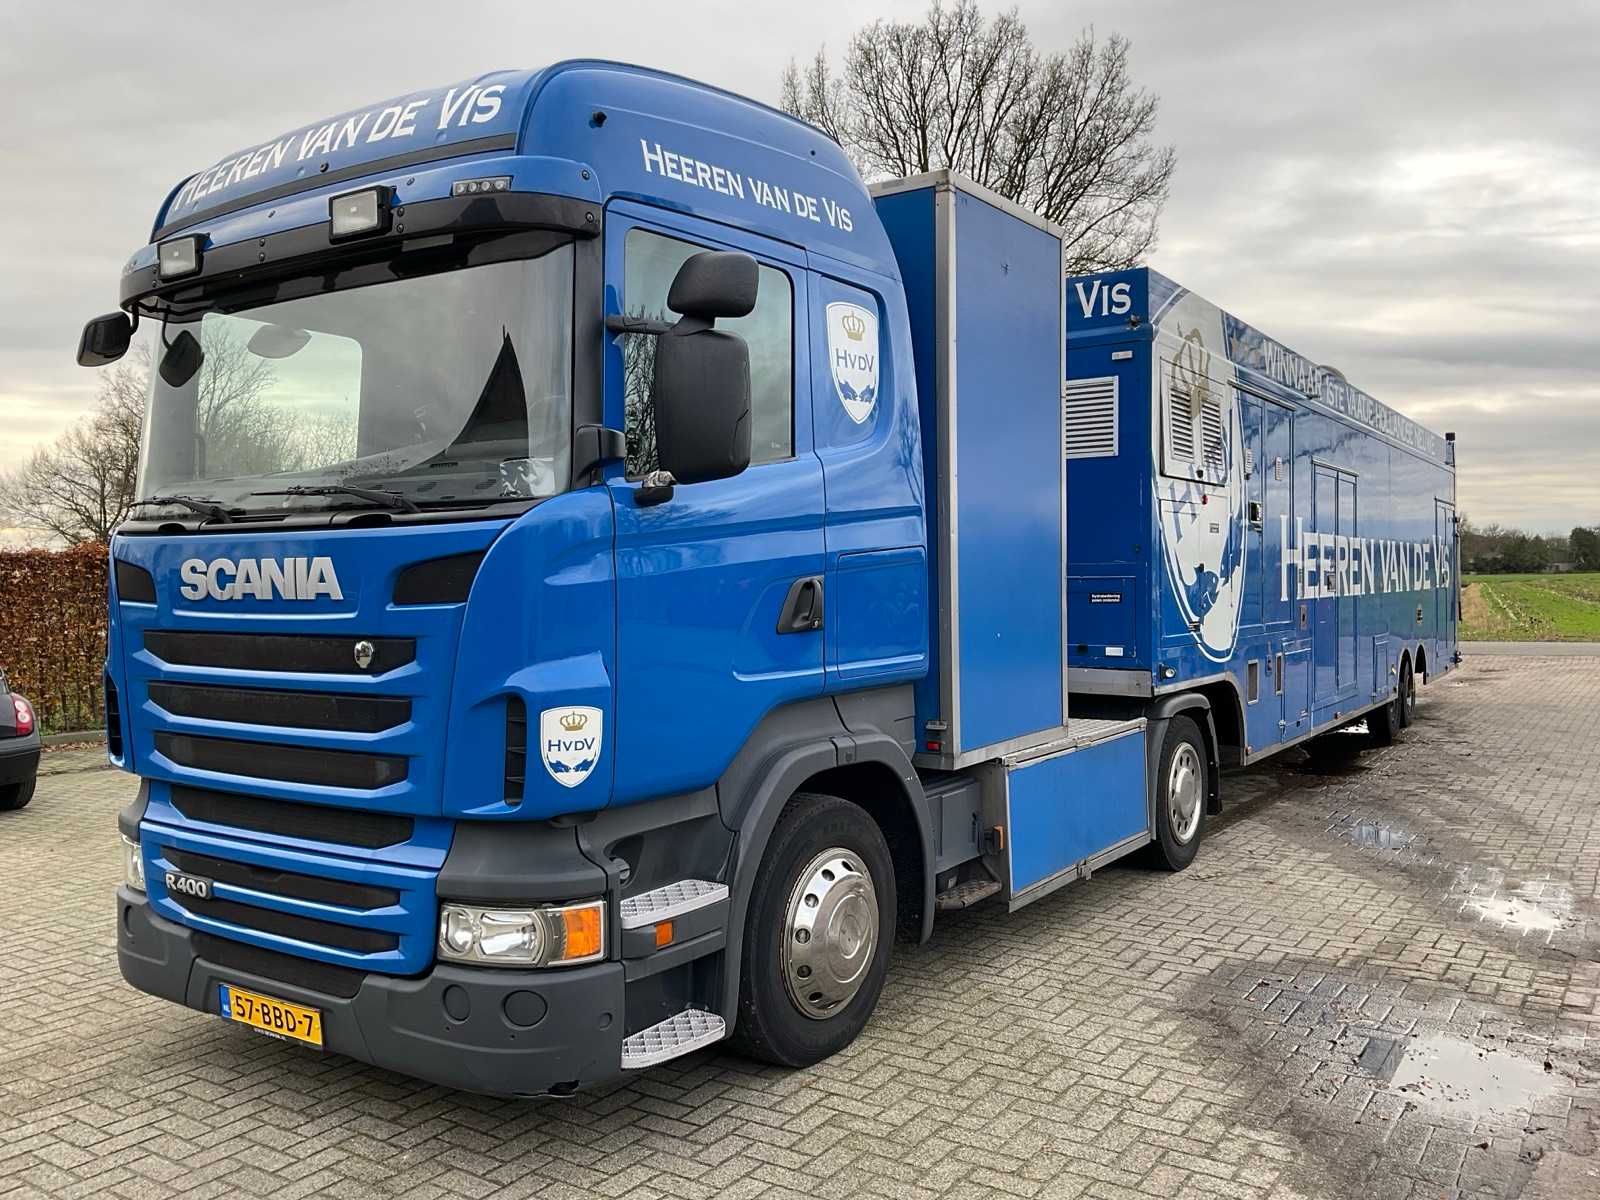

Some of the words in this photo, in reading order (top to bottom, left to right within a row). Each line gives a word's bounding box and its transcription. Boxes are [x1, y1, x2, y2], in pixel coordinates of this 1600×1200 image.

[173, 136, 297, 211] HEEREN
[296, 114, 369, 161] VAN
[367, 99, 430, 144] DE
[437, 84, 506, 129] VIS
[640, 139, 745, 199] HEEREN
[748, 177, 791, 213] VAN
[793, 193, 821, 223] DE
[822, 197, 853, 232] VIS
[1075, 280, 1131, 318] VIS
[1263, 339, 1322, 398] WINNAAR
[180, 557, 344, 600] SCANIA
[1280, 514, 1374, 602] HEEREN
[1379, 539, 1410, 593] VAN
[1414, 543, 1431, 591] DE
[235, 994, 313, 1037] 57-BBD-7
